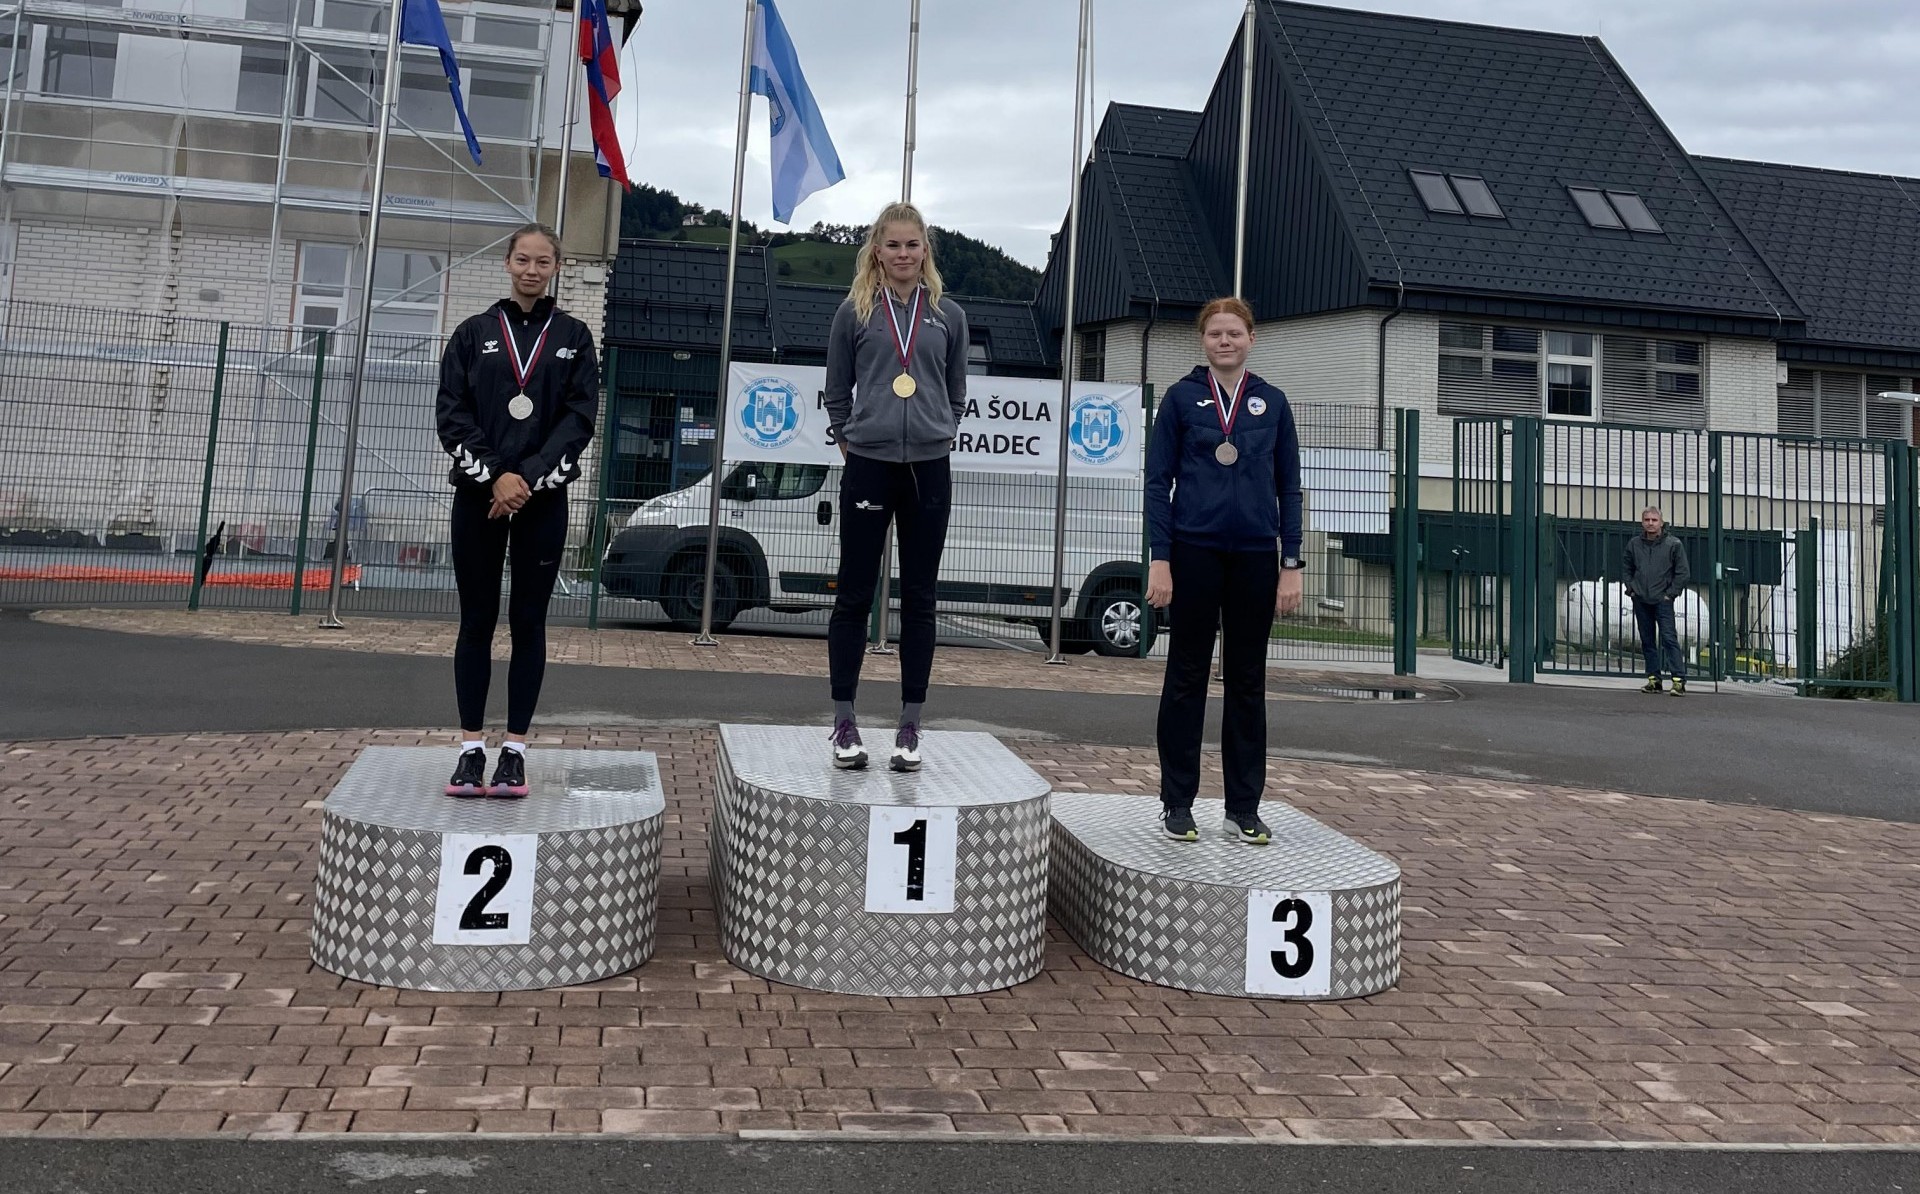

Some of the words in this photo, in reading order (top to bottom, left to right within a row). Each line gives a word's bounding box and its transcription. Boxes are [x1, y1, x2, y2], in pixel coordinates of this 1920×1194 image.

[770, 435, 793, 447] GRADEC
[988, 395, 1052, 422] ŠOLA
[459, 845, 513, 930] 2
[894, 819, 927, 901] 1
[1270, 898, 1314, 979] 3
